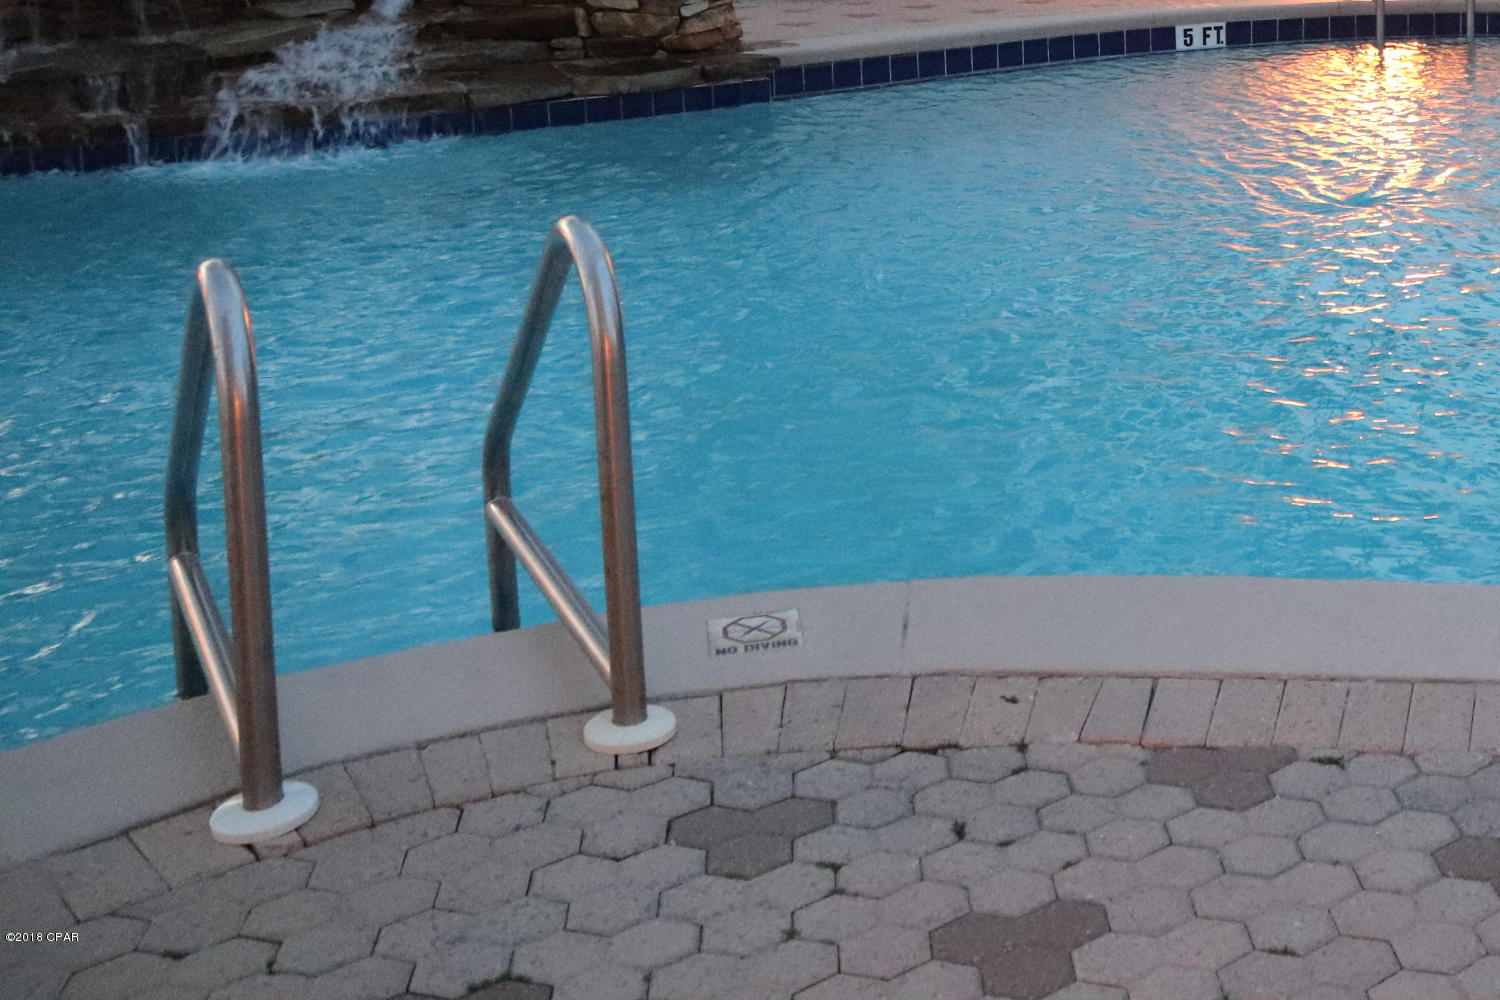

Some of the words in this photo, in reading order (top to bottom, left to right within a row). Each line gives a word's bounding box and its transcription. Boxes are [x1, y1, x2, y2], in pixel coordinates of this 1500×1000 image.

[1183, 28, 1194, 47] 5
[1202, 26, 1224, 46] FT.
[715, 646, 738, 656] NO
[744, 638, 798, 652] DIVING
